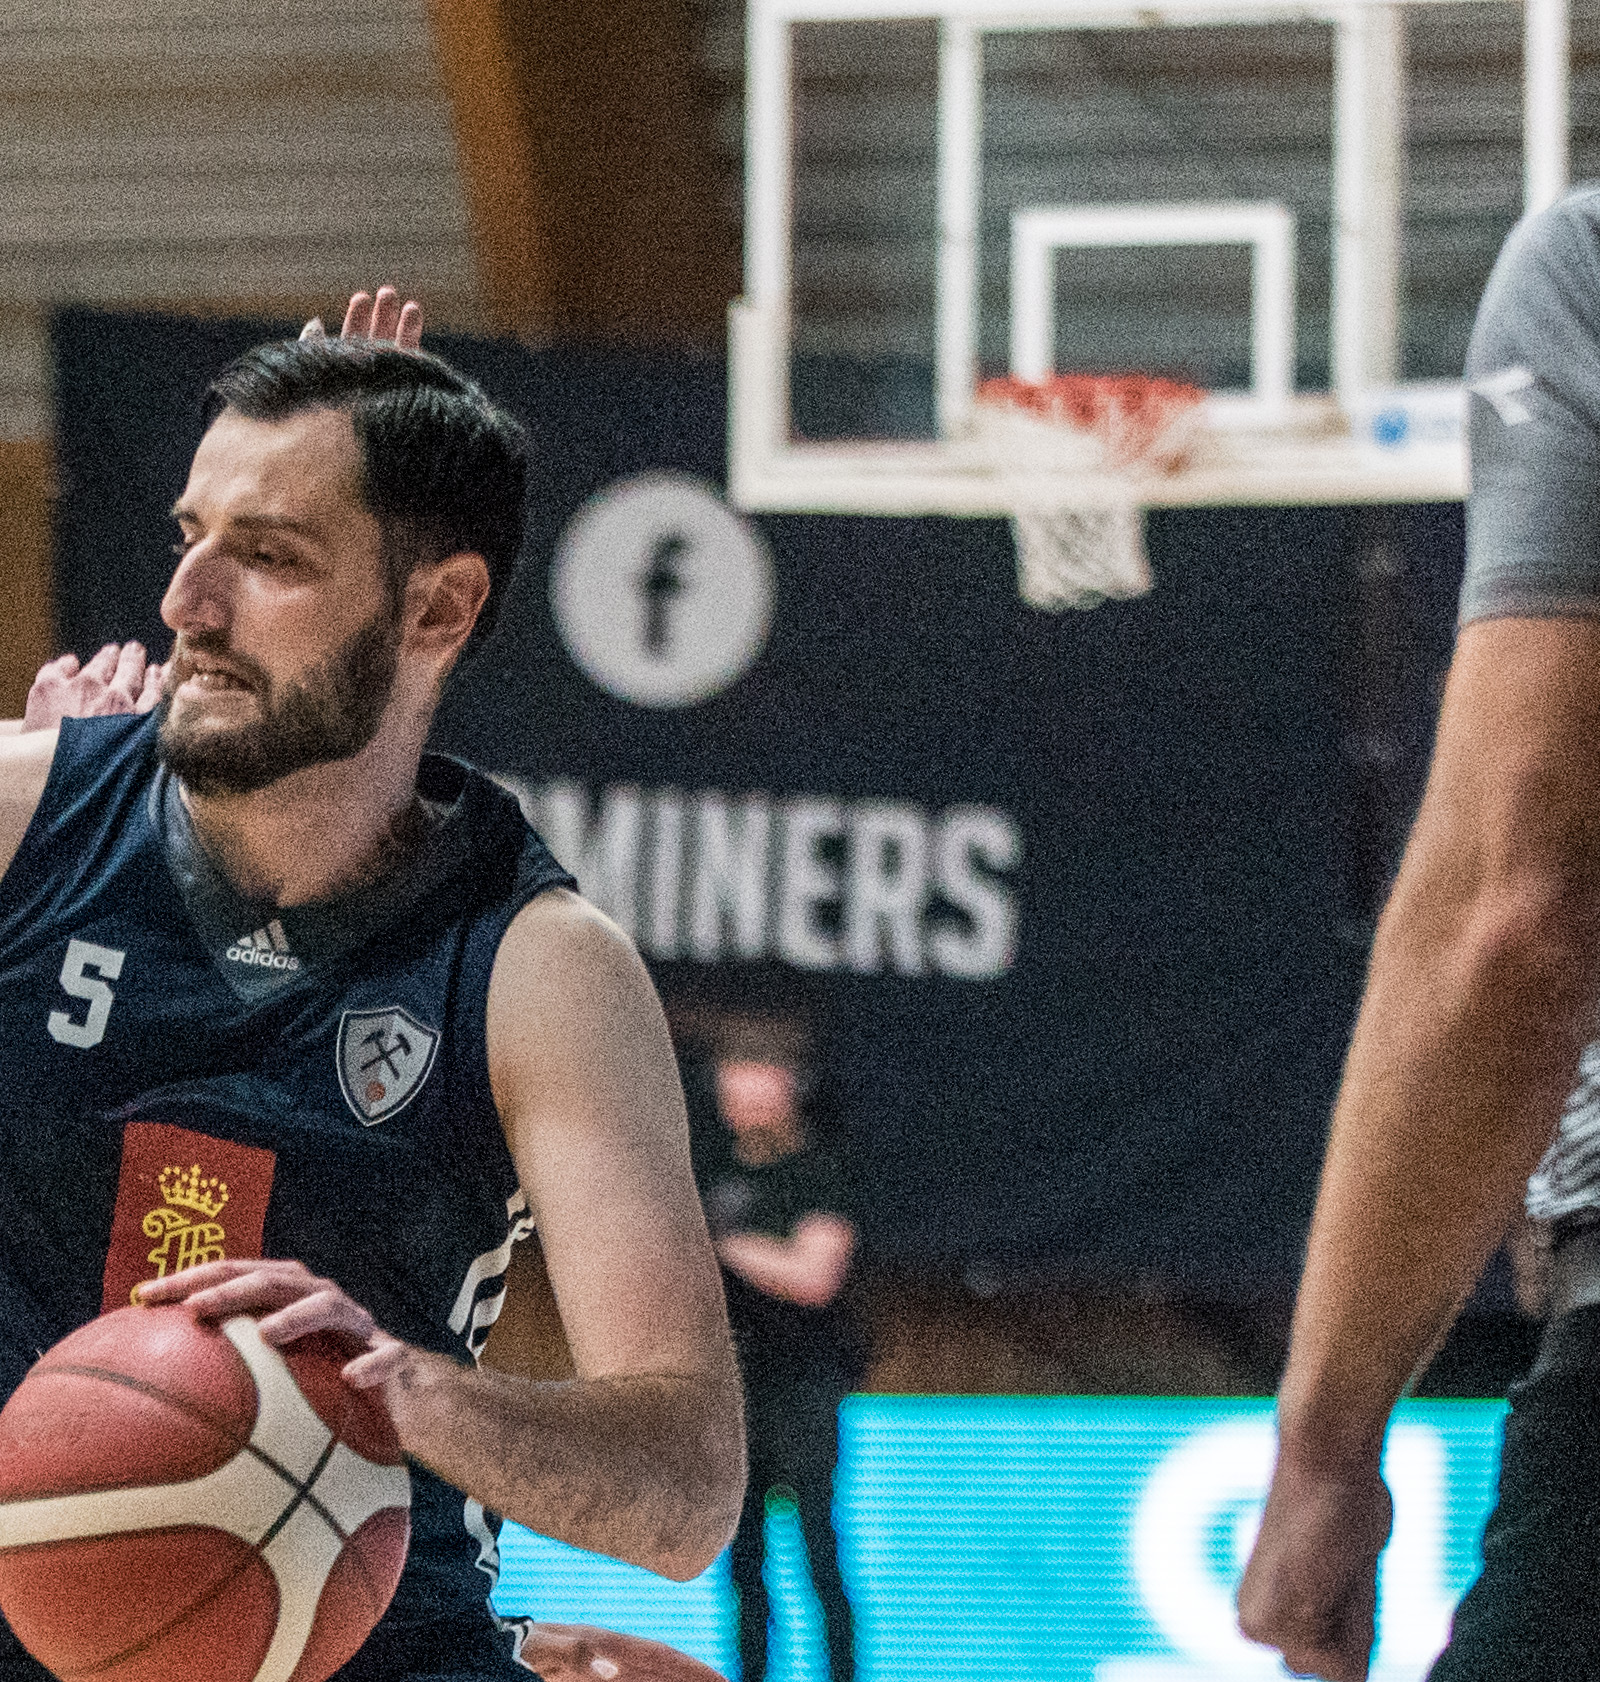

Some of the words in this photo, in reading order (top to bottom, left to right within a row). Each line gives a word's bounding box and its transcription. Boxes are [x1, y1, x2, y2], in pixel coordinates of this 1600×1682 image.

[492, 770, 1024, 980] MINERS
[47, 938, 126, 1050] 5
[226, 944, 300, 971] adidas
